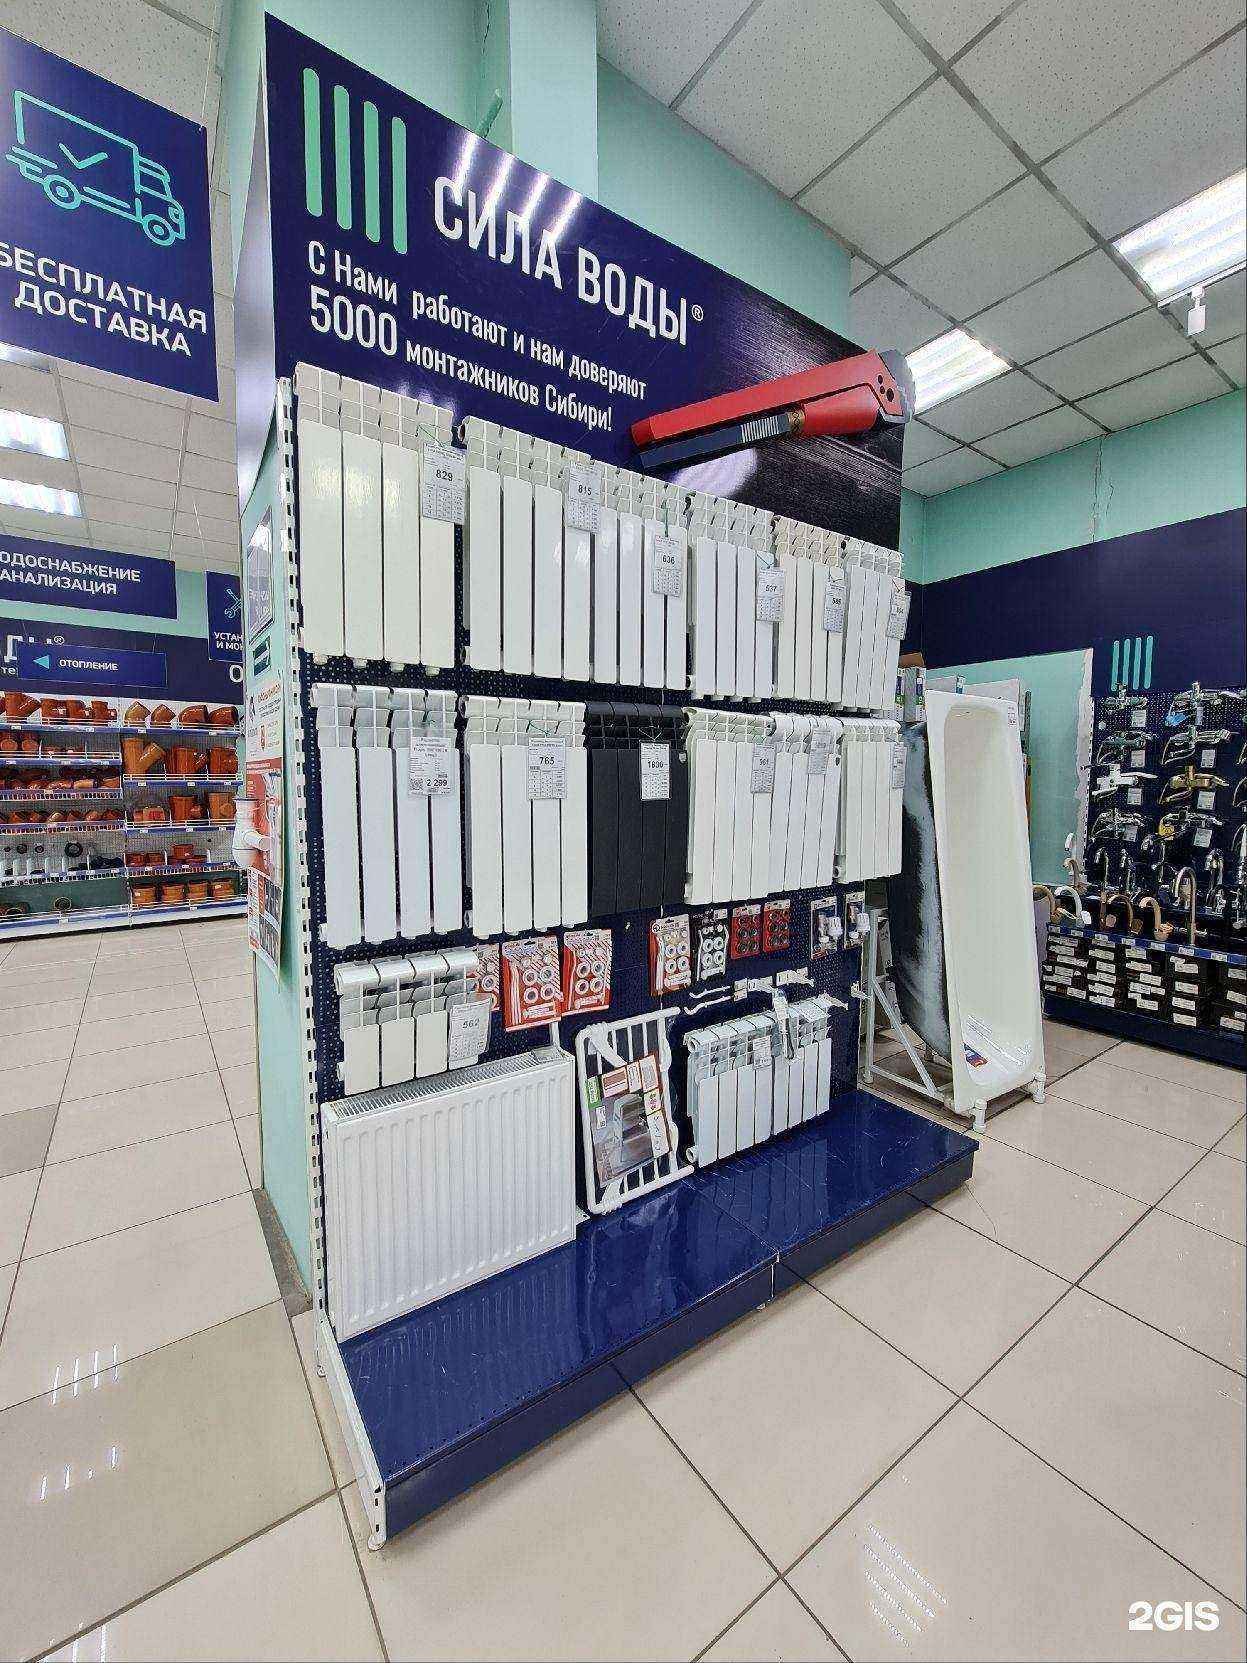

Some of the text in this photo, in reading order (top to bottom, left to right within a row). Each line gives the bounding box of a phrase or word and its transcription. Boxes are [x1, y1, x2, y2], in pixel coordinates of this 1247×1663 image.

[433, 175, 563, 290] СИЛА
[14, 280, 192, 357] ДОСТАВКА
[307, 240, 648, 401] С Нами работают и нам доверяют
[309, 284, 615, 433] 5000 монтажников Сибири!
[435, 469, 453, 482] 829
[577, 484, 592, 496] 815
[59, 658, 119, 671] ОТОПЛЕНИЕ
[539, 756, 555, 766] 765
